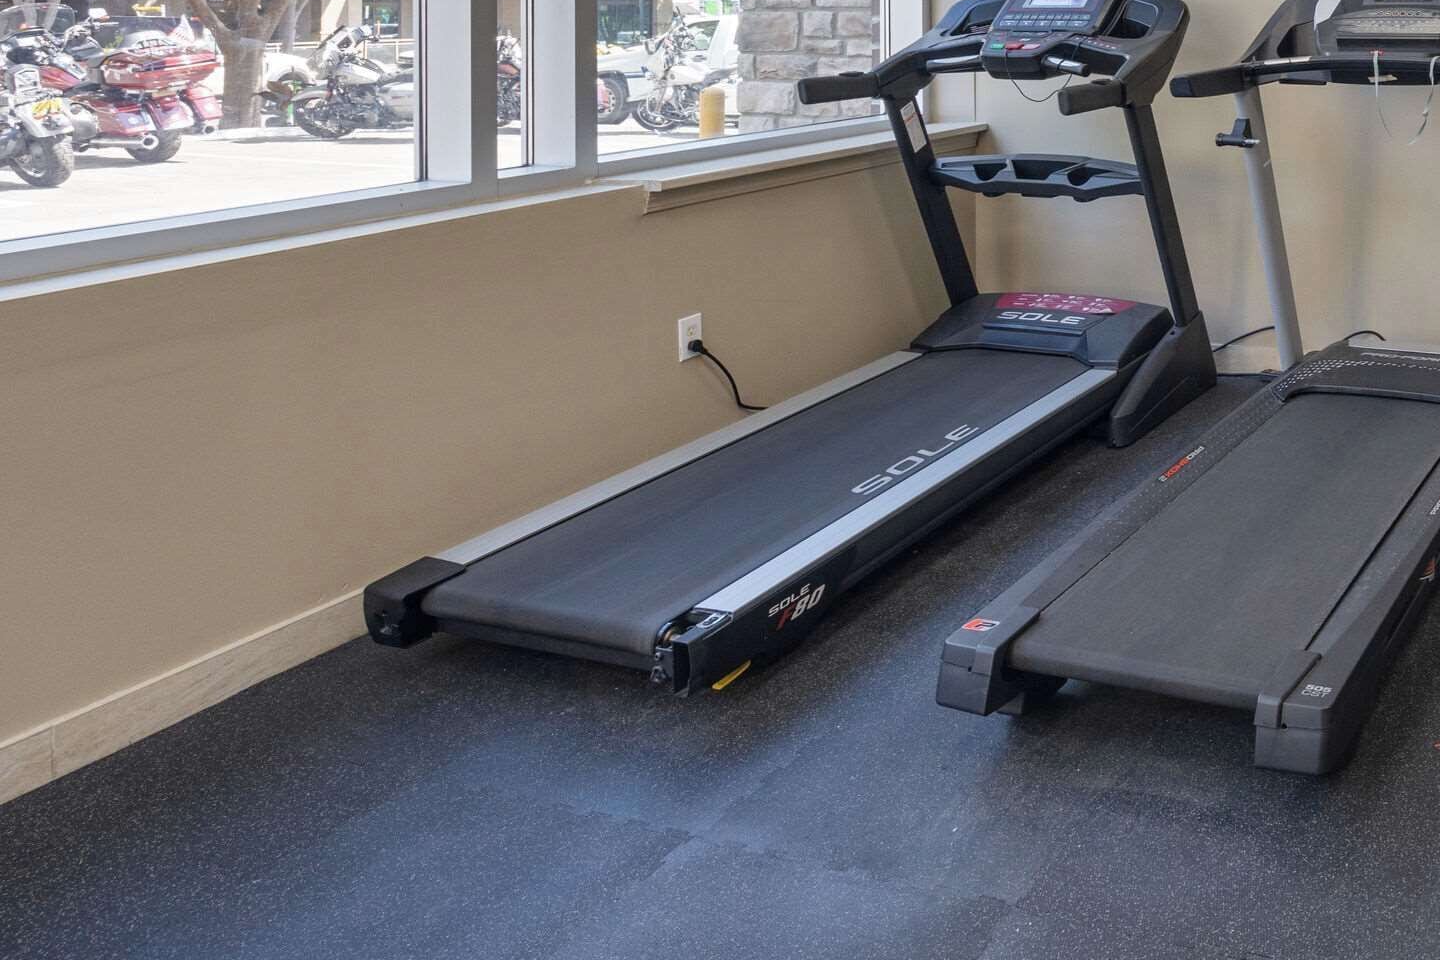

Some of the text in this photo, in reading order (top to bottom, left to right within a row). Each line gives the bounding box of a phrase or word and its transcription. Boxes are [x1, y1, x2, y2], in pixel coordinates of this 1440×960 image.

[996, 311, 1086, 325] SOLE
[850, 424, 980, 496] SOLE
[767, 583, 811, 618] SOLE
[776, 583, 826, 632] F80
